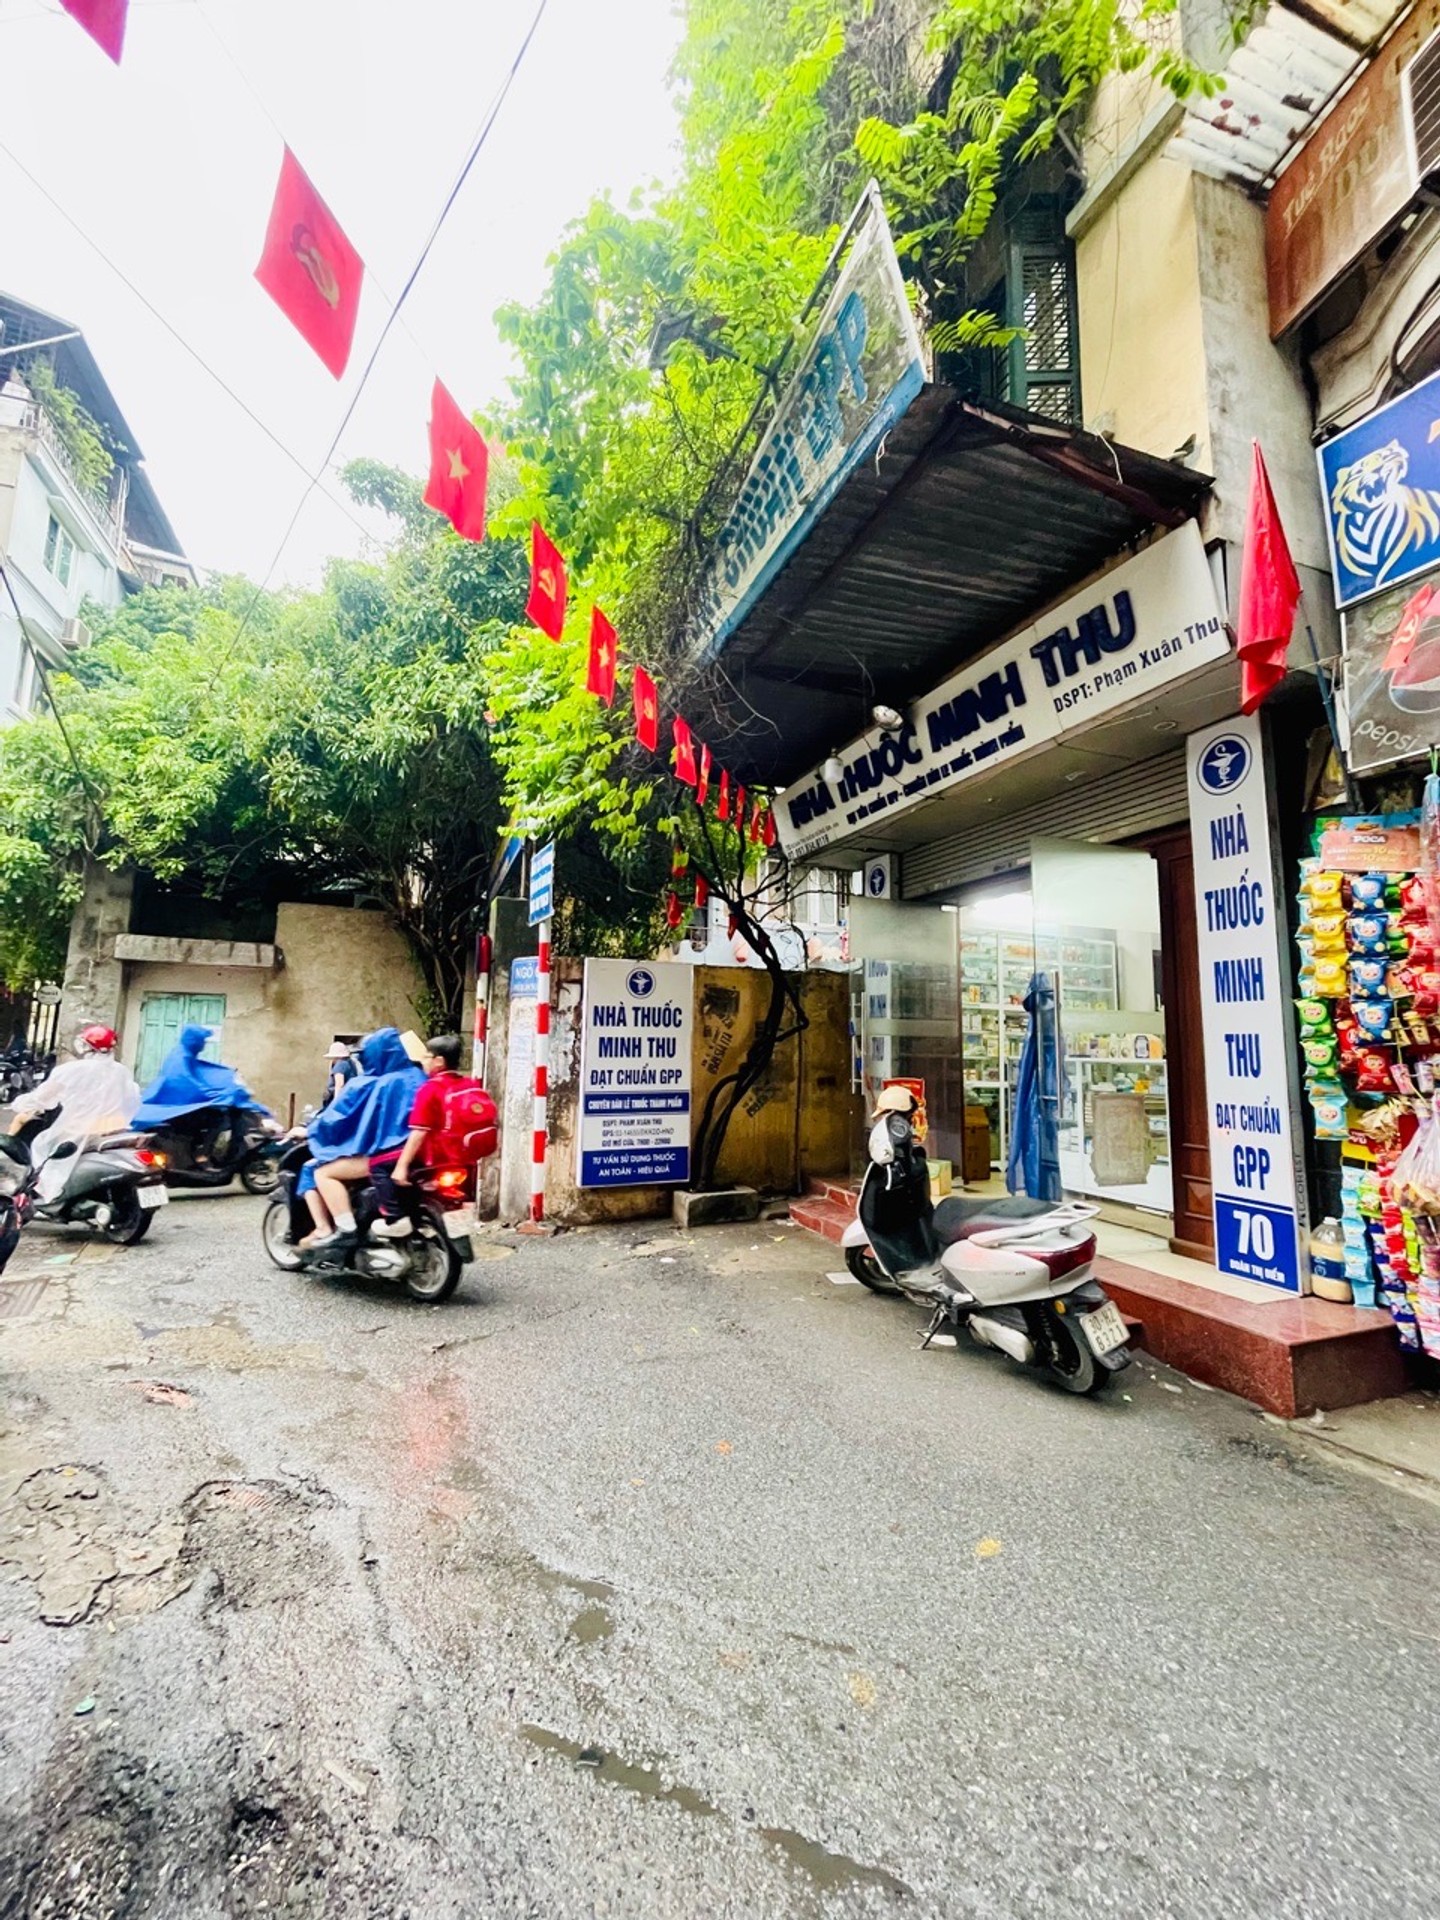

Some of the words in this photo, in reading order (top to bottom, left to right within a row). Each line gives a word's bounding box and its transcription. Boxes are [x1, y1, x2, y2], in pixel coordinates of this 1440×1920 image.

[1053, 683, 1094, 713] DSPT:
[1094, 661, 1137, 692] Phạm
[1139, 637, 1183, 668] Xuân
[1184, 617, 1220, 645] Thu
[788, 773, 836, 829] NHÀ
[838, 722, 922, 802] THUỐC
[927, 661, 1027, 753] MINH
[1030, 590, 1136, 688] THU
[1353, 720, 1421, 752] pepsi
[1210, 803, 1249, 860] NHÀ
[1204, 868, 1264, 932] THUỐC
[1213, 957, 1265, 1002] MINH
[593, 1001, 627, 1027] NHÀ
[632, 1000, 682, 1028] THUỐC
[599, 1036, 641, 1058] MINH
[647, 1037, 676, 1058] THU
[1224, 1033, 1261, 1078] THU
[590, 1069, 613, 1089] ĐẠT
[617, 1063, 656, 1085] CHUẨN
[660, 1069, 682, 1084] GPP
[1216, 1103, 1236, 1135] ĐẠT
[1241, 1095, 1281, 1134] CHUẨN
[599, 1168, 610, 1176] AN
[653, 1151, 676, 1161] THUỐC
[1233, 1144, 1270, 1190] GPP
[1233, 1209, 1275, 1261] 70
